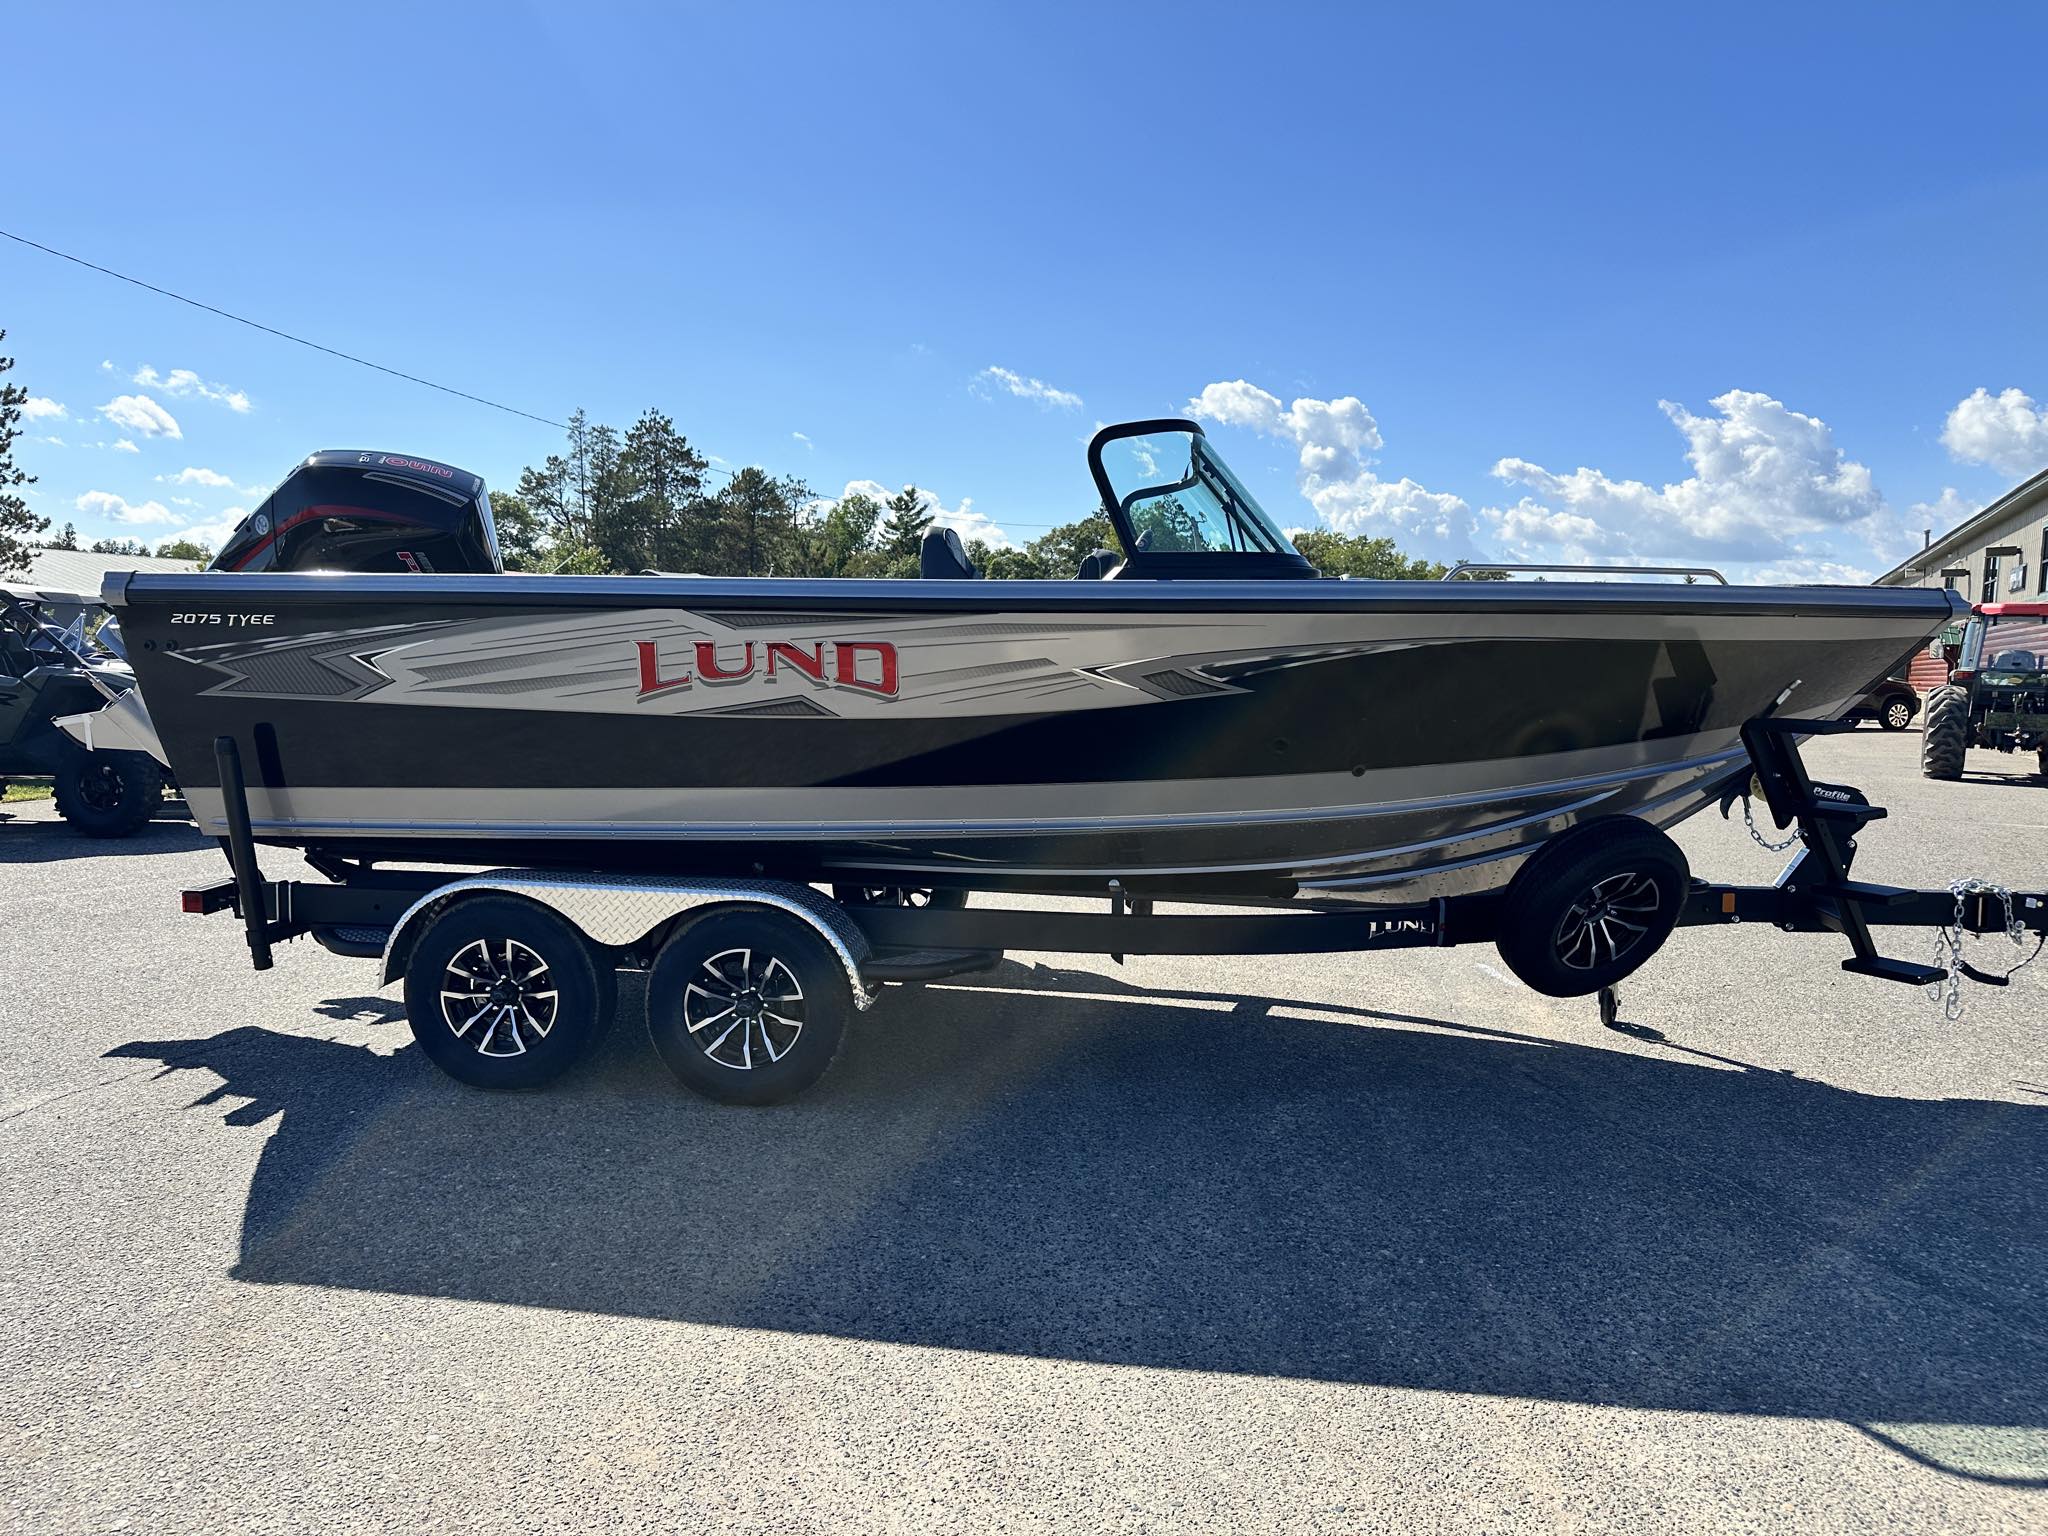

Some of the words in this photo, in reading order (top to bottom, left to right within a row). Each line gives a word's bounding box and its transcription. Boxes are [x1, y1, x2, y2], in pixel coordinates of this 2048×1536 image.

[170, 613, 222, 624] 2075
[227, 614, 276, 627] TYEE
[632, 640, 900, 699] LUND
[1813, 786, 1851, 800] Profile
